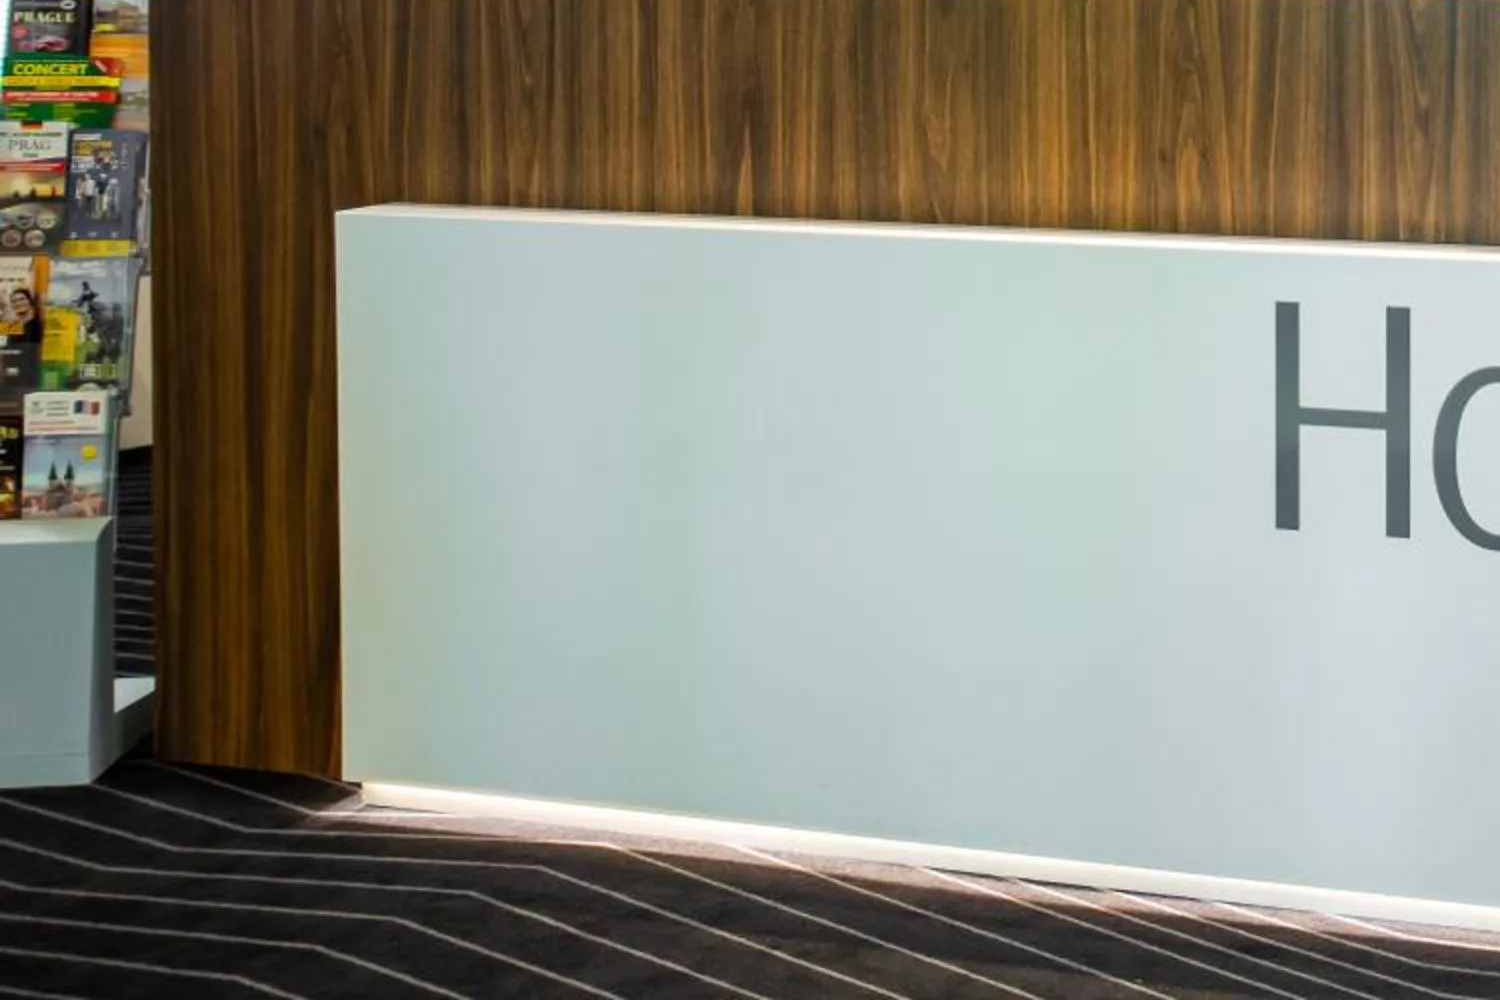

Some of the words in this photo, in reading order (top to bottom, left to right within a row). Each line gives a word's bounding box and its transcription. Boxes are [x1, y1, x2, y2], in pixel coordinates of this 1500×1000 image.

[13, 11, 75, 23] PRAGUE
[13, 63, 88, 75] CONCERT
[8, 138, 52, 151] PRAG
